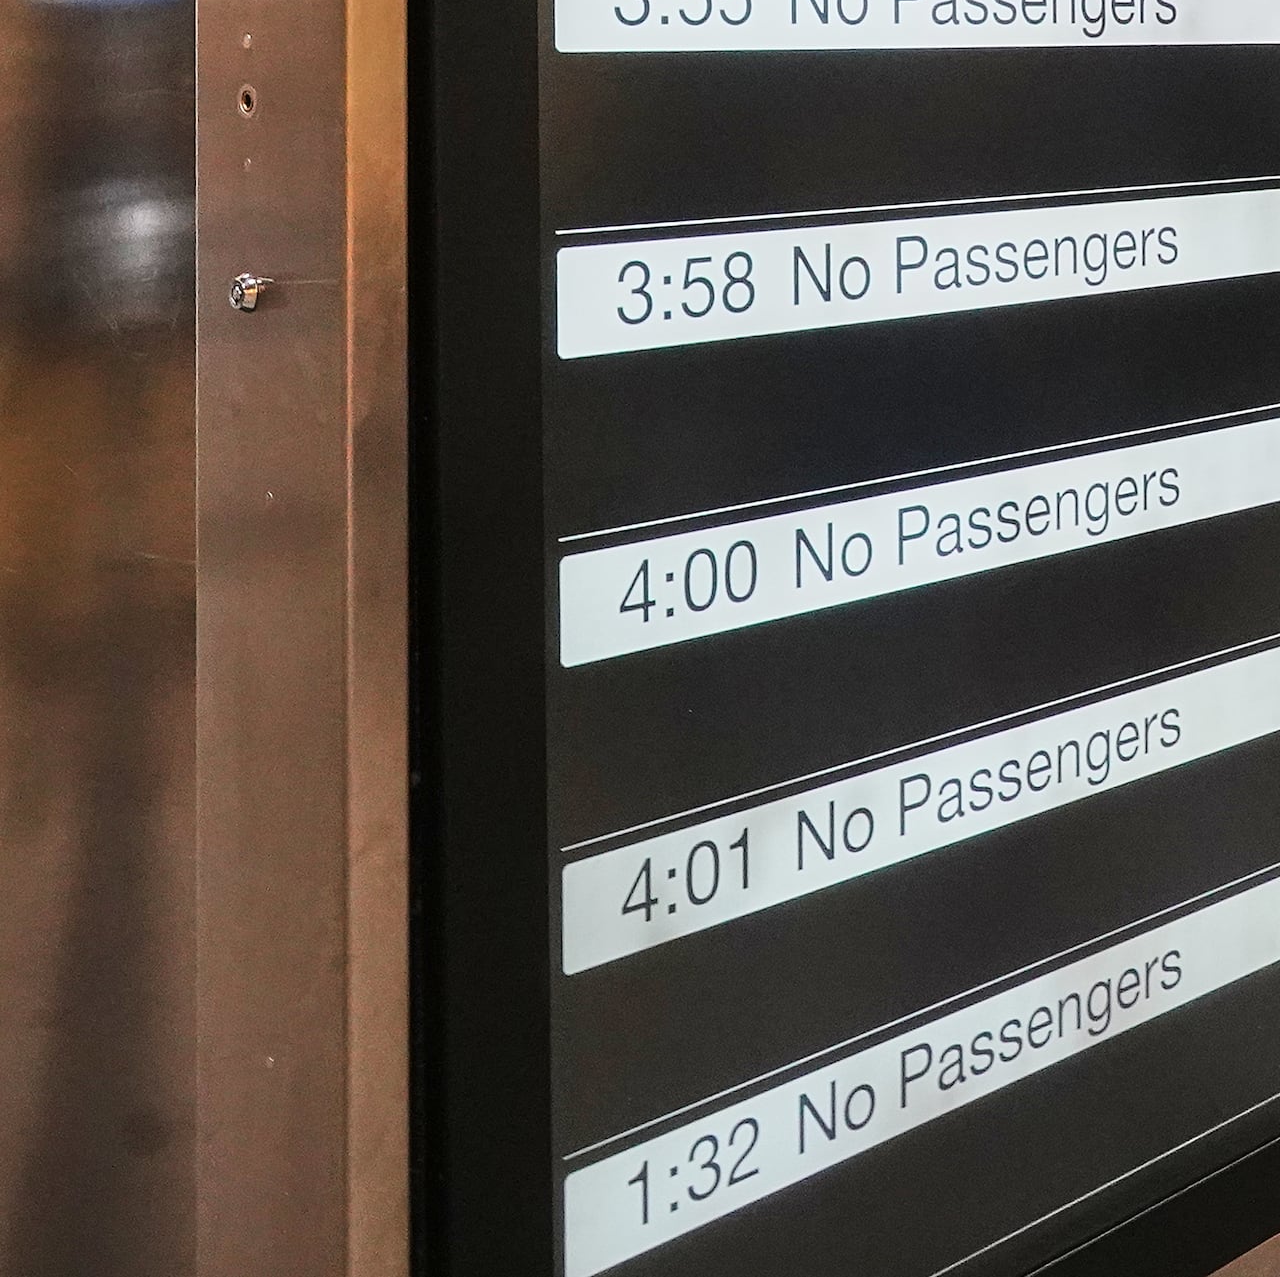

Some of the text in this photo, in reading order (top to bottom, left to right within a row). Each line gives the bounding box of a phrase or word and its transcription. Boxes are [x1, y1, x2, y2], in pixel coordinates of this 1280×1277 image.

[618, 227, 1178, 324] 3:58 No Passengers
[620, 468, 1179, 622] 4:00 No Passengers
[622, 709, 1180, 922] 4:01 No Passengers
[629, 951, 1181, 1224] 1:32 No Passengers
